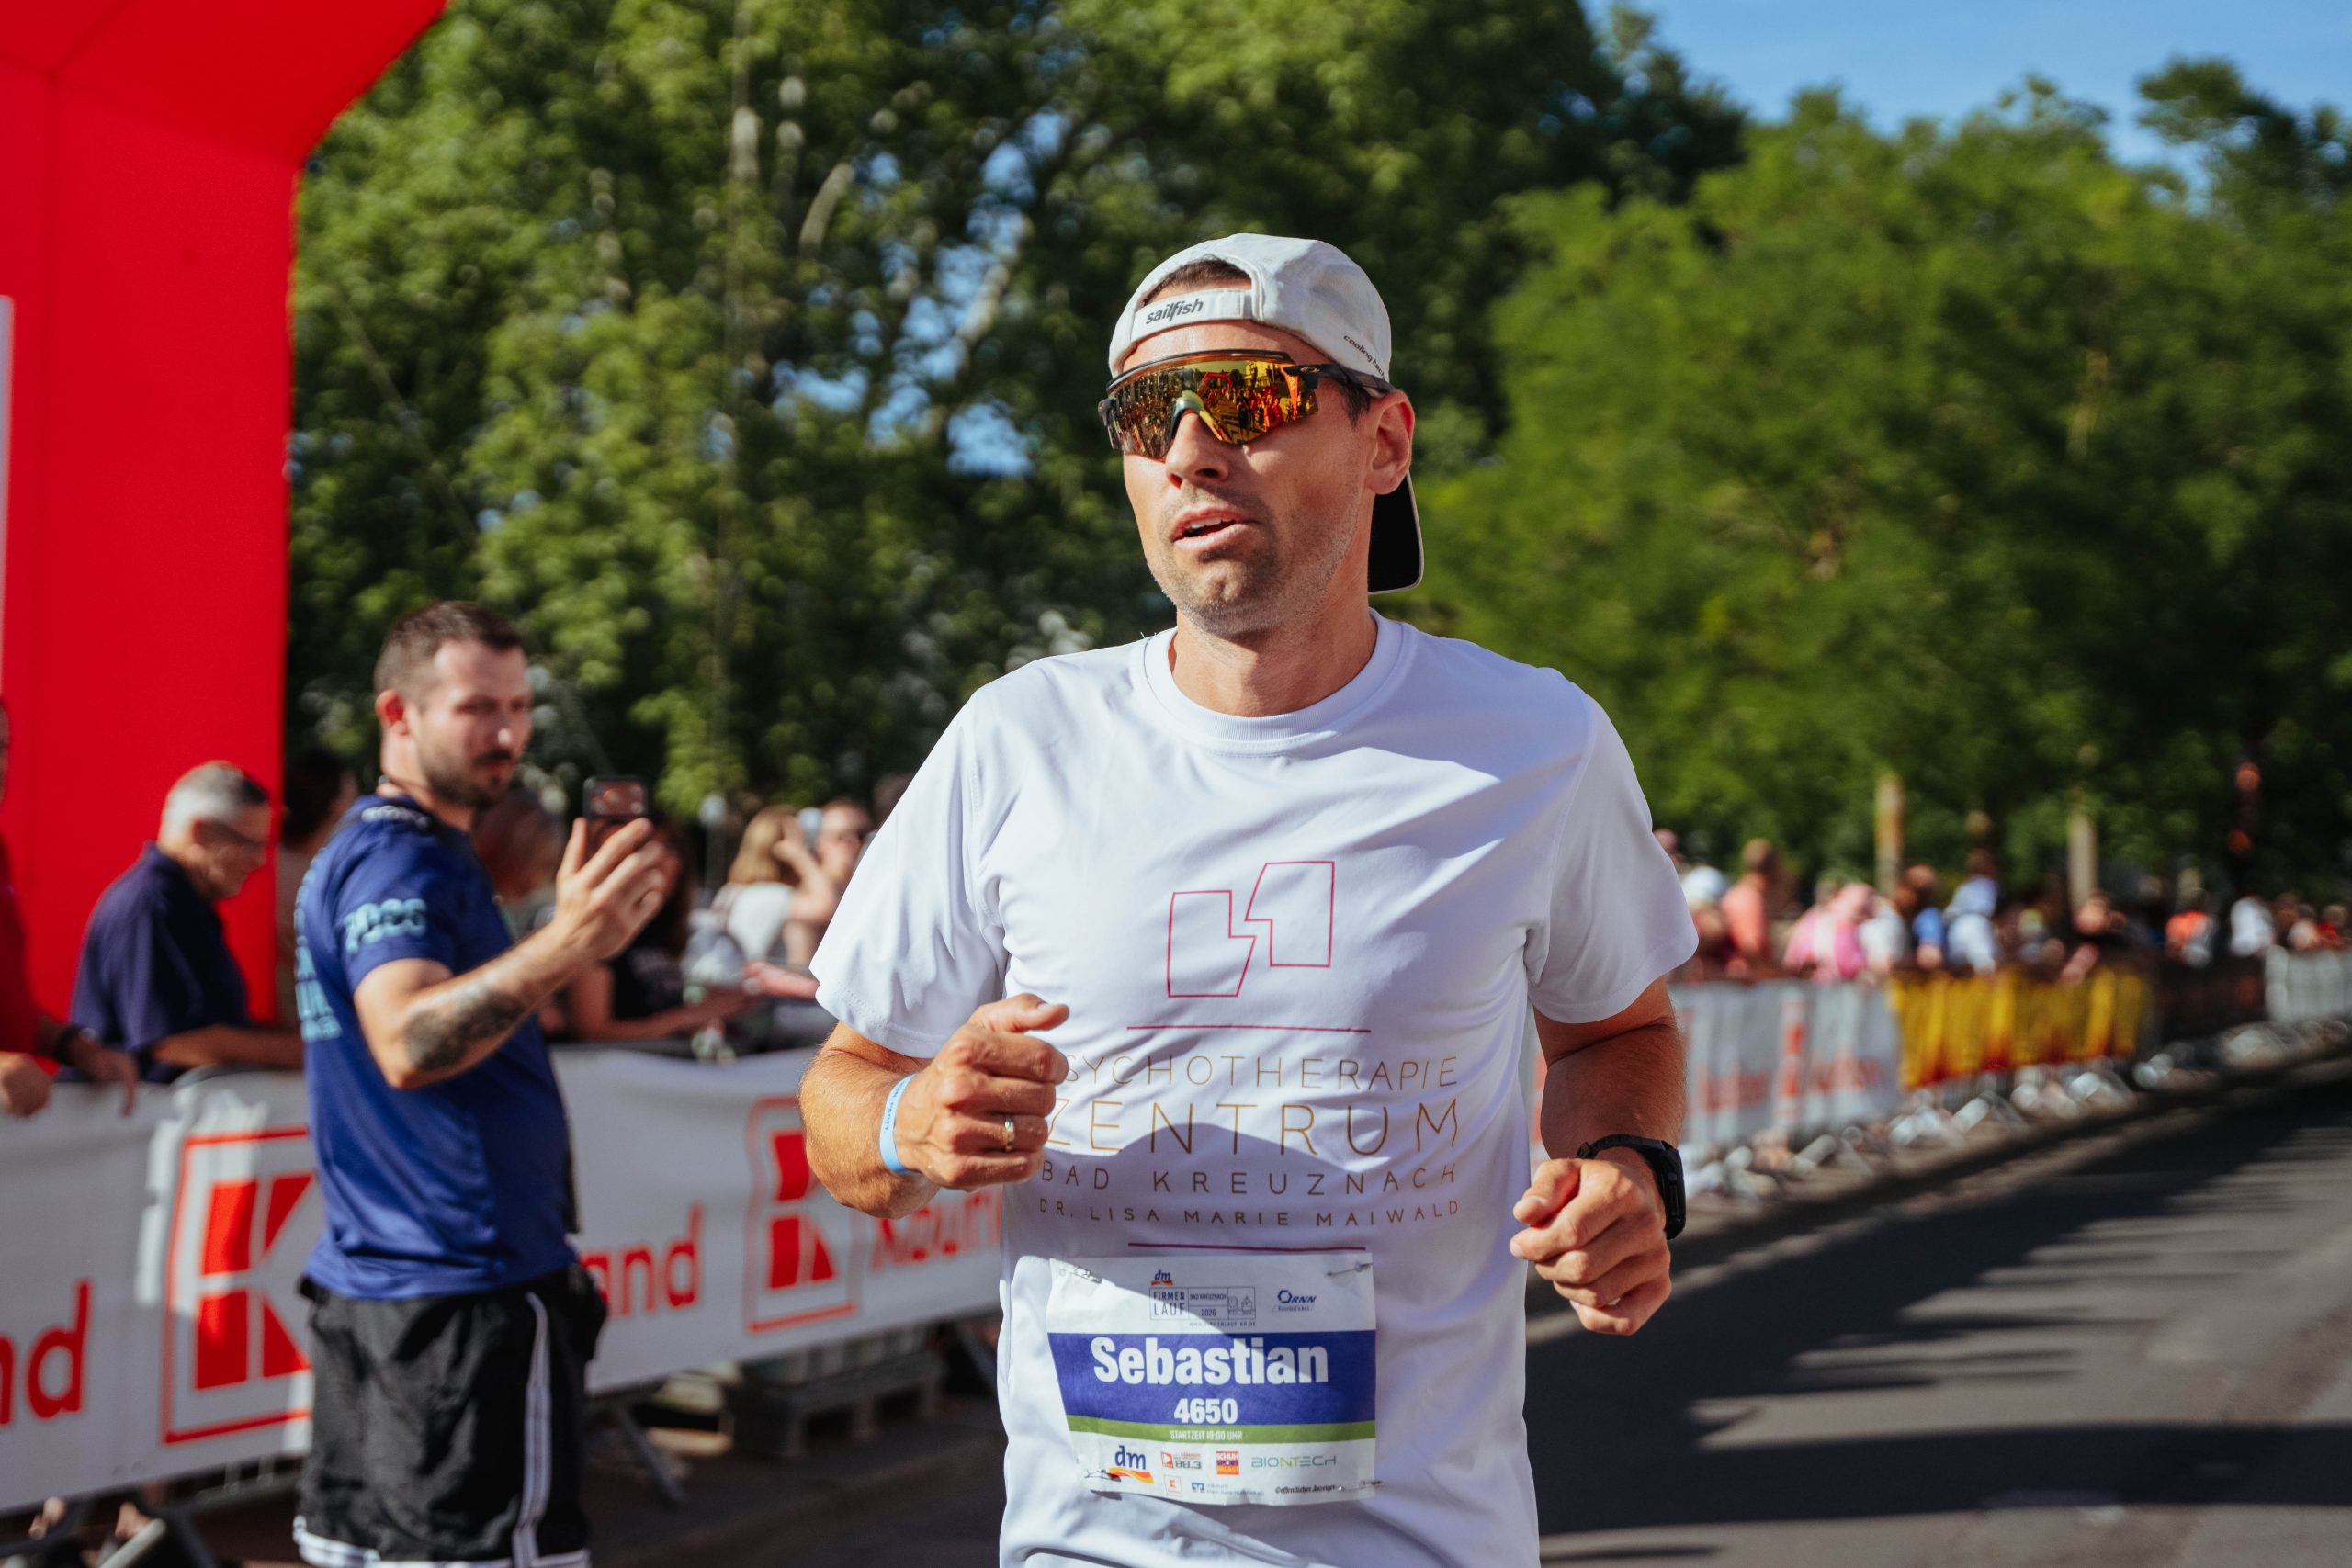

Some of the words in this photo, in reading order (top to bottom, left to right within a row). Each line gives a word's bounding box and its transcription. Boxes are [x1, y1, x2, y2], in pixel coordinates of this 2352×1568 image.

[1146, 298, 1204, 324] sailfish
[1343, 335, 1373, 363] cooling
[1066, 1054, 1458, 1091] SYCHOTHERAPIE
[1046, 1098, 1458, 1156] ZENTRUM
[1042, 1160, 1110, 1190] BAD
[1153, 1164, 1456, 1196] KREUZNACH
[1039, 1198, 1074, 1218] DR.
[1090, 1206, 1160, 1221] LISA
[1184, 1210, 1289, 1226] MARIE
[1316, 1200, 1459, 1227] MAIWALD
[1154, 1269, 1171, 1281] dm
[1153, 1292, 1185, 1300] FIRMEN
[1153, 1303, 1186, 1316] LAUF
[1091, 1337, 1329, 1385] Sebastian
[1173, 1398, 1238, 1424] 4650
[1170, 1429, 1205, 1440] STARTZEIT
[1227, 1430, 1243, 1441] UHR
[1114, 1445, 1147, 1470] dm
[1175, 1461, 1202, 1470] 88.3
